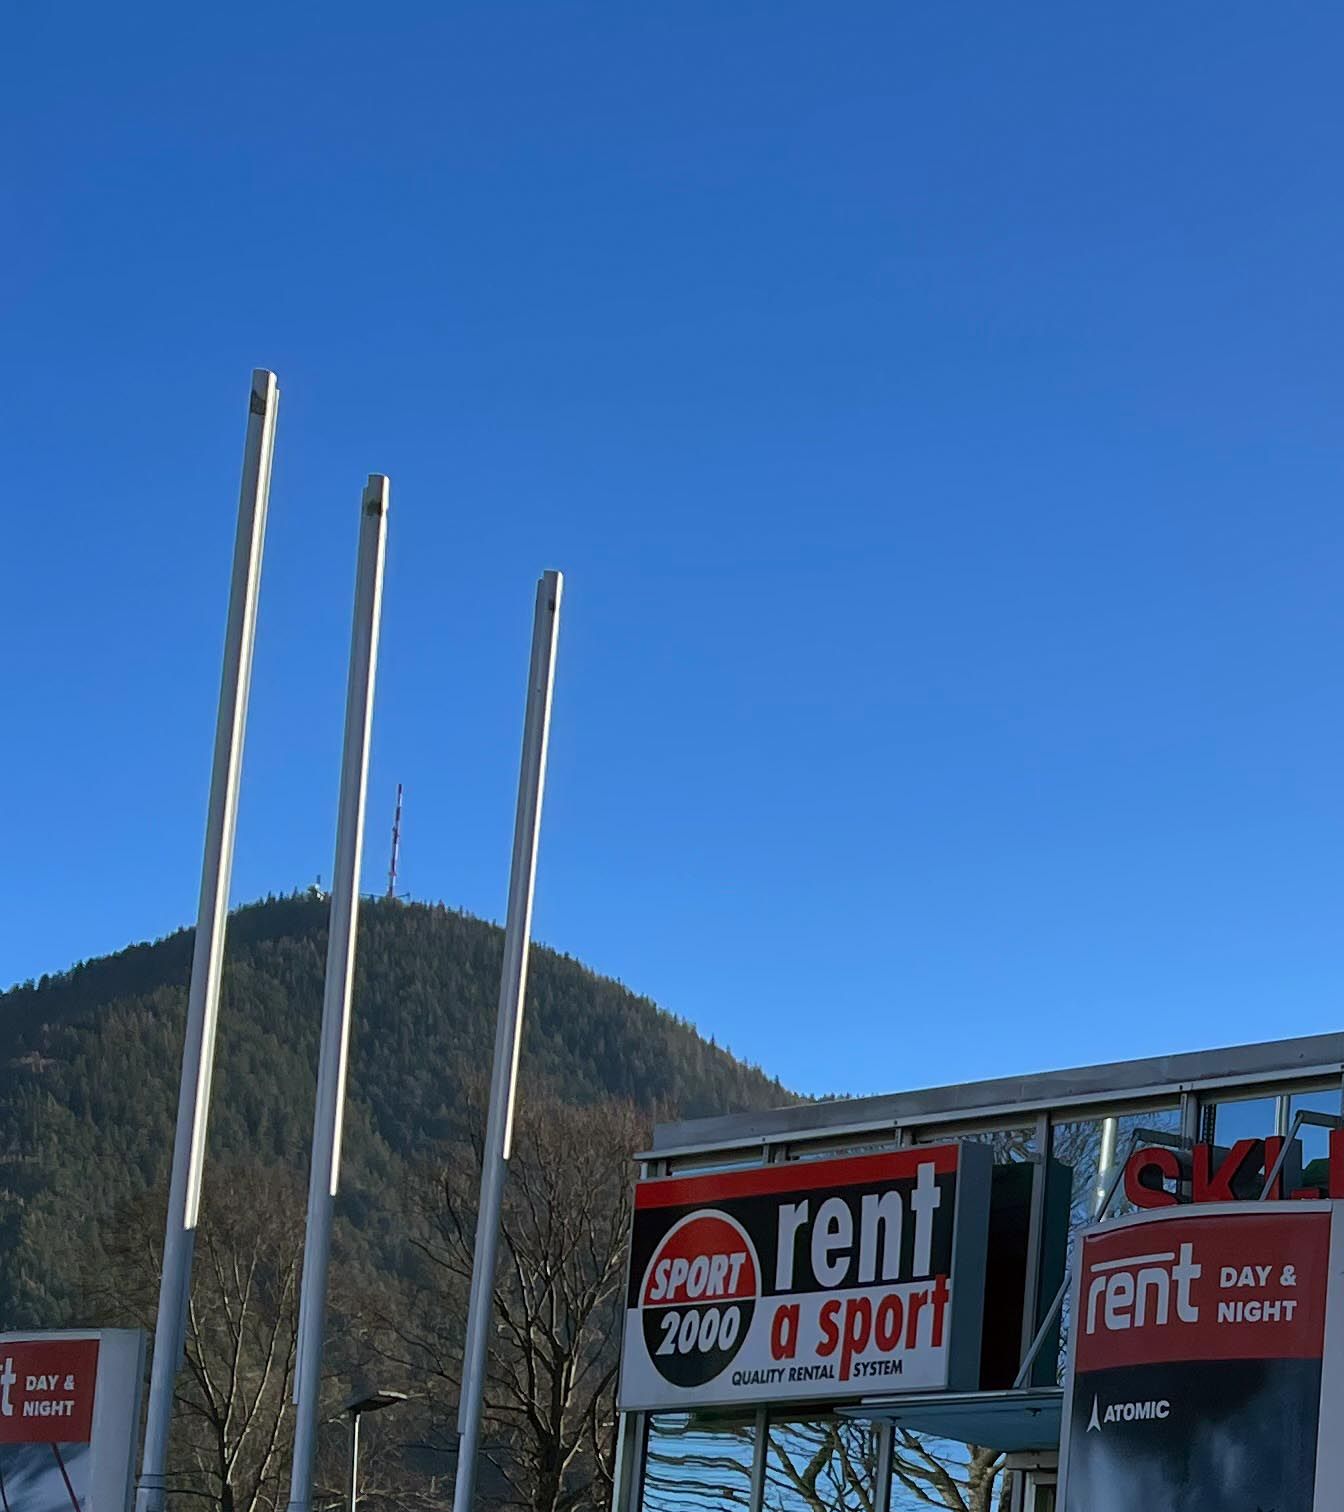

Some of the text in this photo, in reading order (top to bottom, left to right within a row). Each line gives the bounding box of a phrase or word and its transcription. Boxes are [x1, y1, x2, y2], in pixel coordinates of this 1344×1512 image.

[774, 1161, 942, 1291] rent
[649, 1251, 747, 1300] SPORT
[1085, 1242, 1202, 1335] rent
[1219, 1264, 1297, 1288] DAY &
[1216, 1300, 1298, 1323] NIGHT
[655, 1305, 741, 1356] 2000
[770, 1274, 950, 1381] a sport
[25, 1374, 75, 1391] DAY &
[731, 1359, 903, 1386] QUALITY RENTAL SYSTEM
[22, 1400, 75, 1417] NIGHT
[1103, 1399, 1171, 1424] ATOMIC
